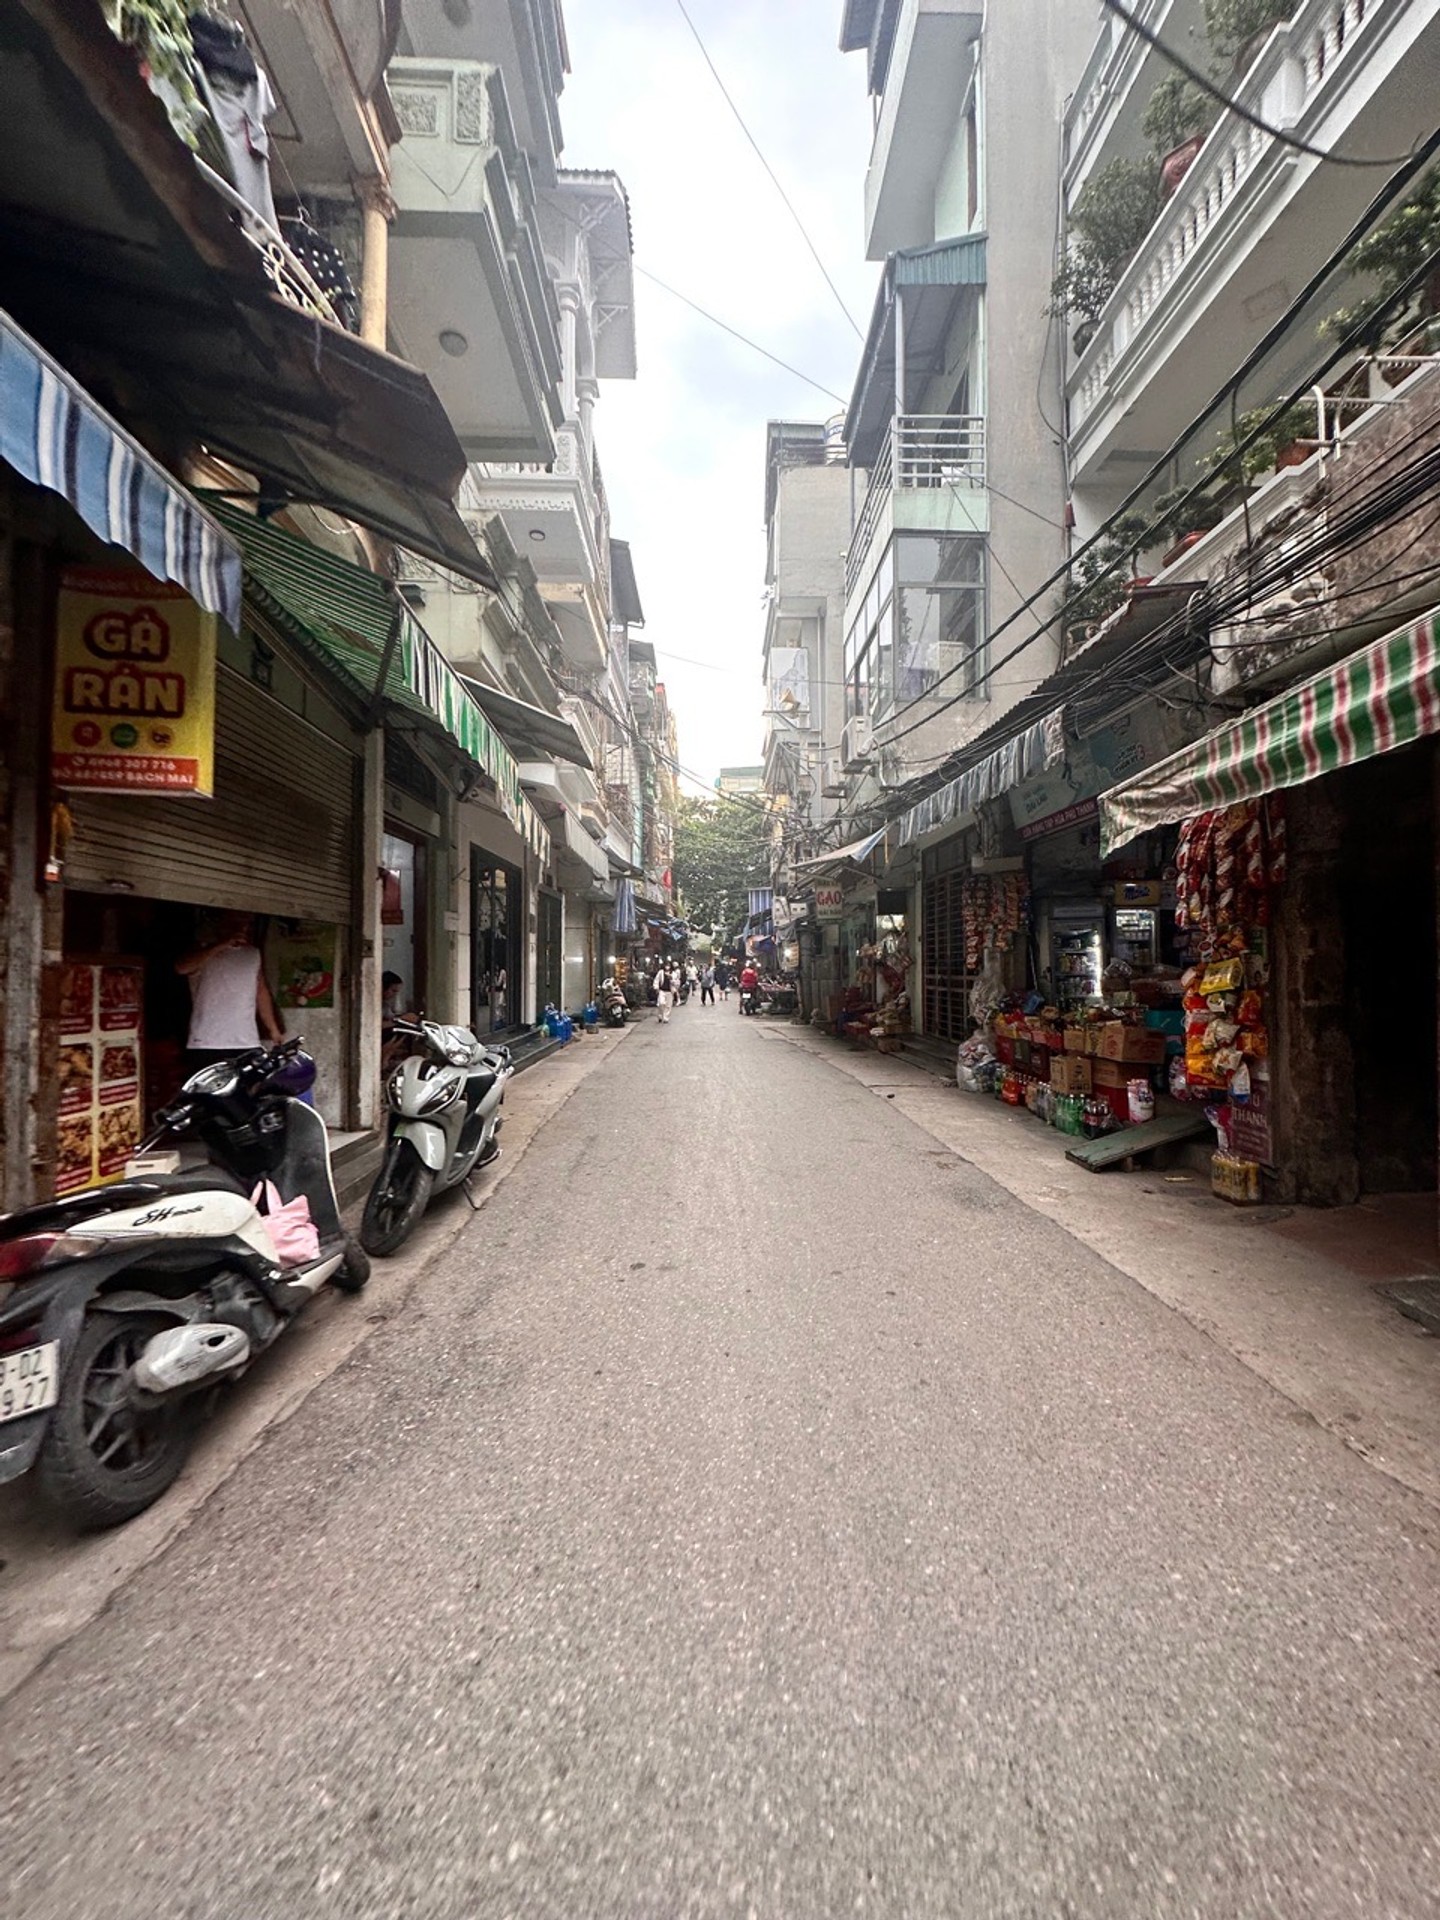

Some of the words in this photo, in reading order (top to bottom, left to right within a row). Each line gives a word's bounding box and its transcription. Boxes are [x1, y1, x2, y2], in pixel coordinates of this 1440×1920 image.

[89, 611, 164, 657] GÀ
[167, 773, 194, 784] MAI
[817, 890, 841, 907] GẠO
